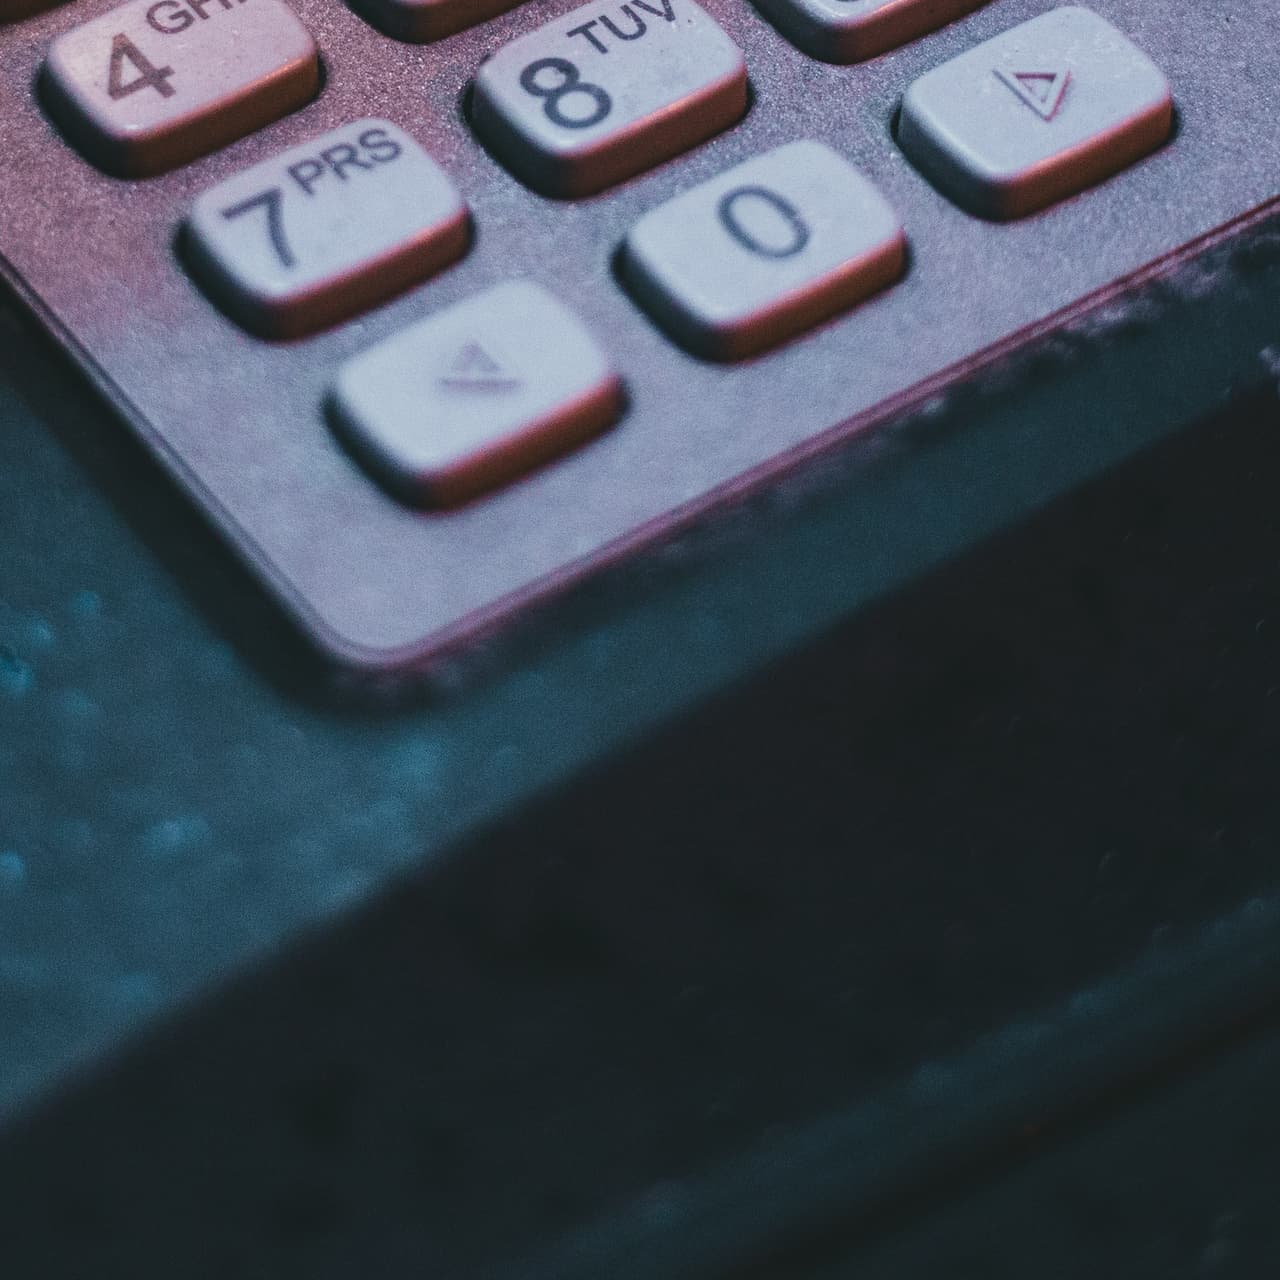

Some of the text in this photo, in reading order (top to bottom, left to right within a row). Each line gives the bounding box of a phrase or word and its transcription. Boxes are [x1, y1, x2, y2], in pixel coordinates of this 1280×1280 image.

[106, 33, 175, 101] 4
[519, 58, 612, 129] 8
[222, 128, 403, 269] 7 PRS
[719, 184, 810, 258] 0
